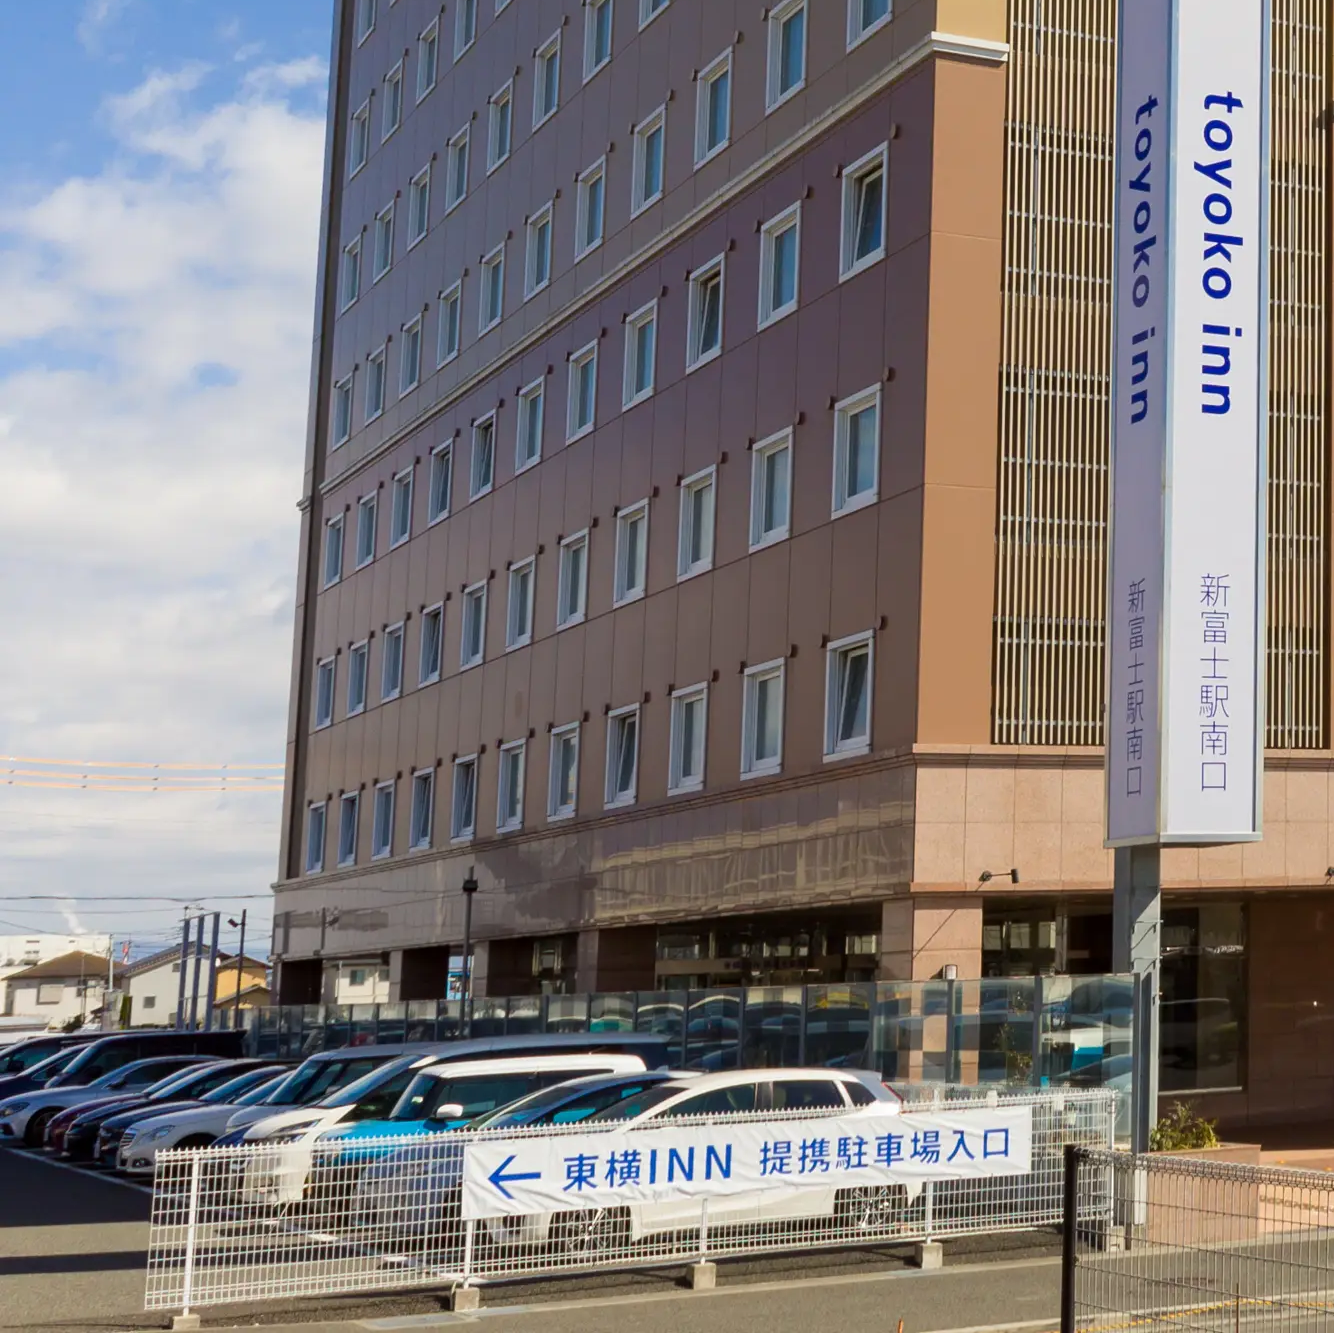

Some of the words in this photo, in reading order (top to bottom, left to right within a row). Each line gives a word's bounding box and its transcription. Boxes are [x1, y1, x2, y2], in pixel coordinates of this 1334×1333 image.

[1128, 94, 1160, 309] toyoko
[1193, 91, 1245, 300] toyoko
[1130, 326, 1156, 425] inn
[1201, 323, 1243, 416] inn
[1125, 577, 1147, 799] 新富士駅南口
[1198, 572, 1231, 793] 新富士駅南口
[562, 1143, 733, 1192] 東横INN
[758, 1128, 1010, 1176] 提携駐車場入口
